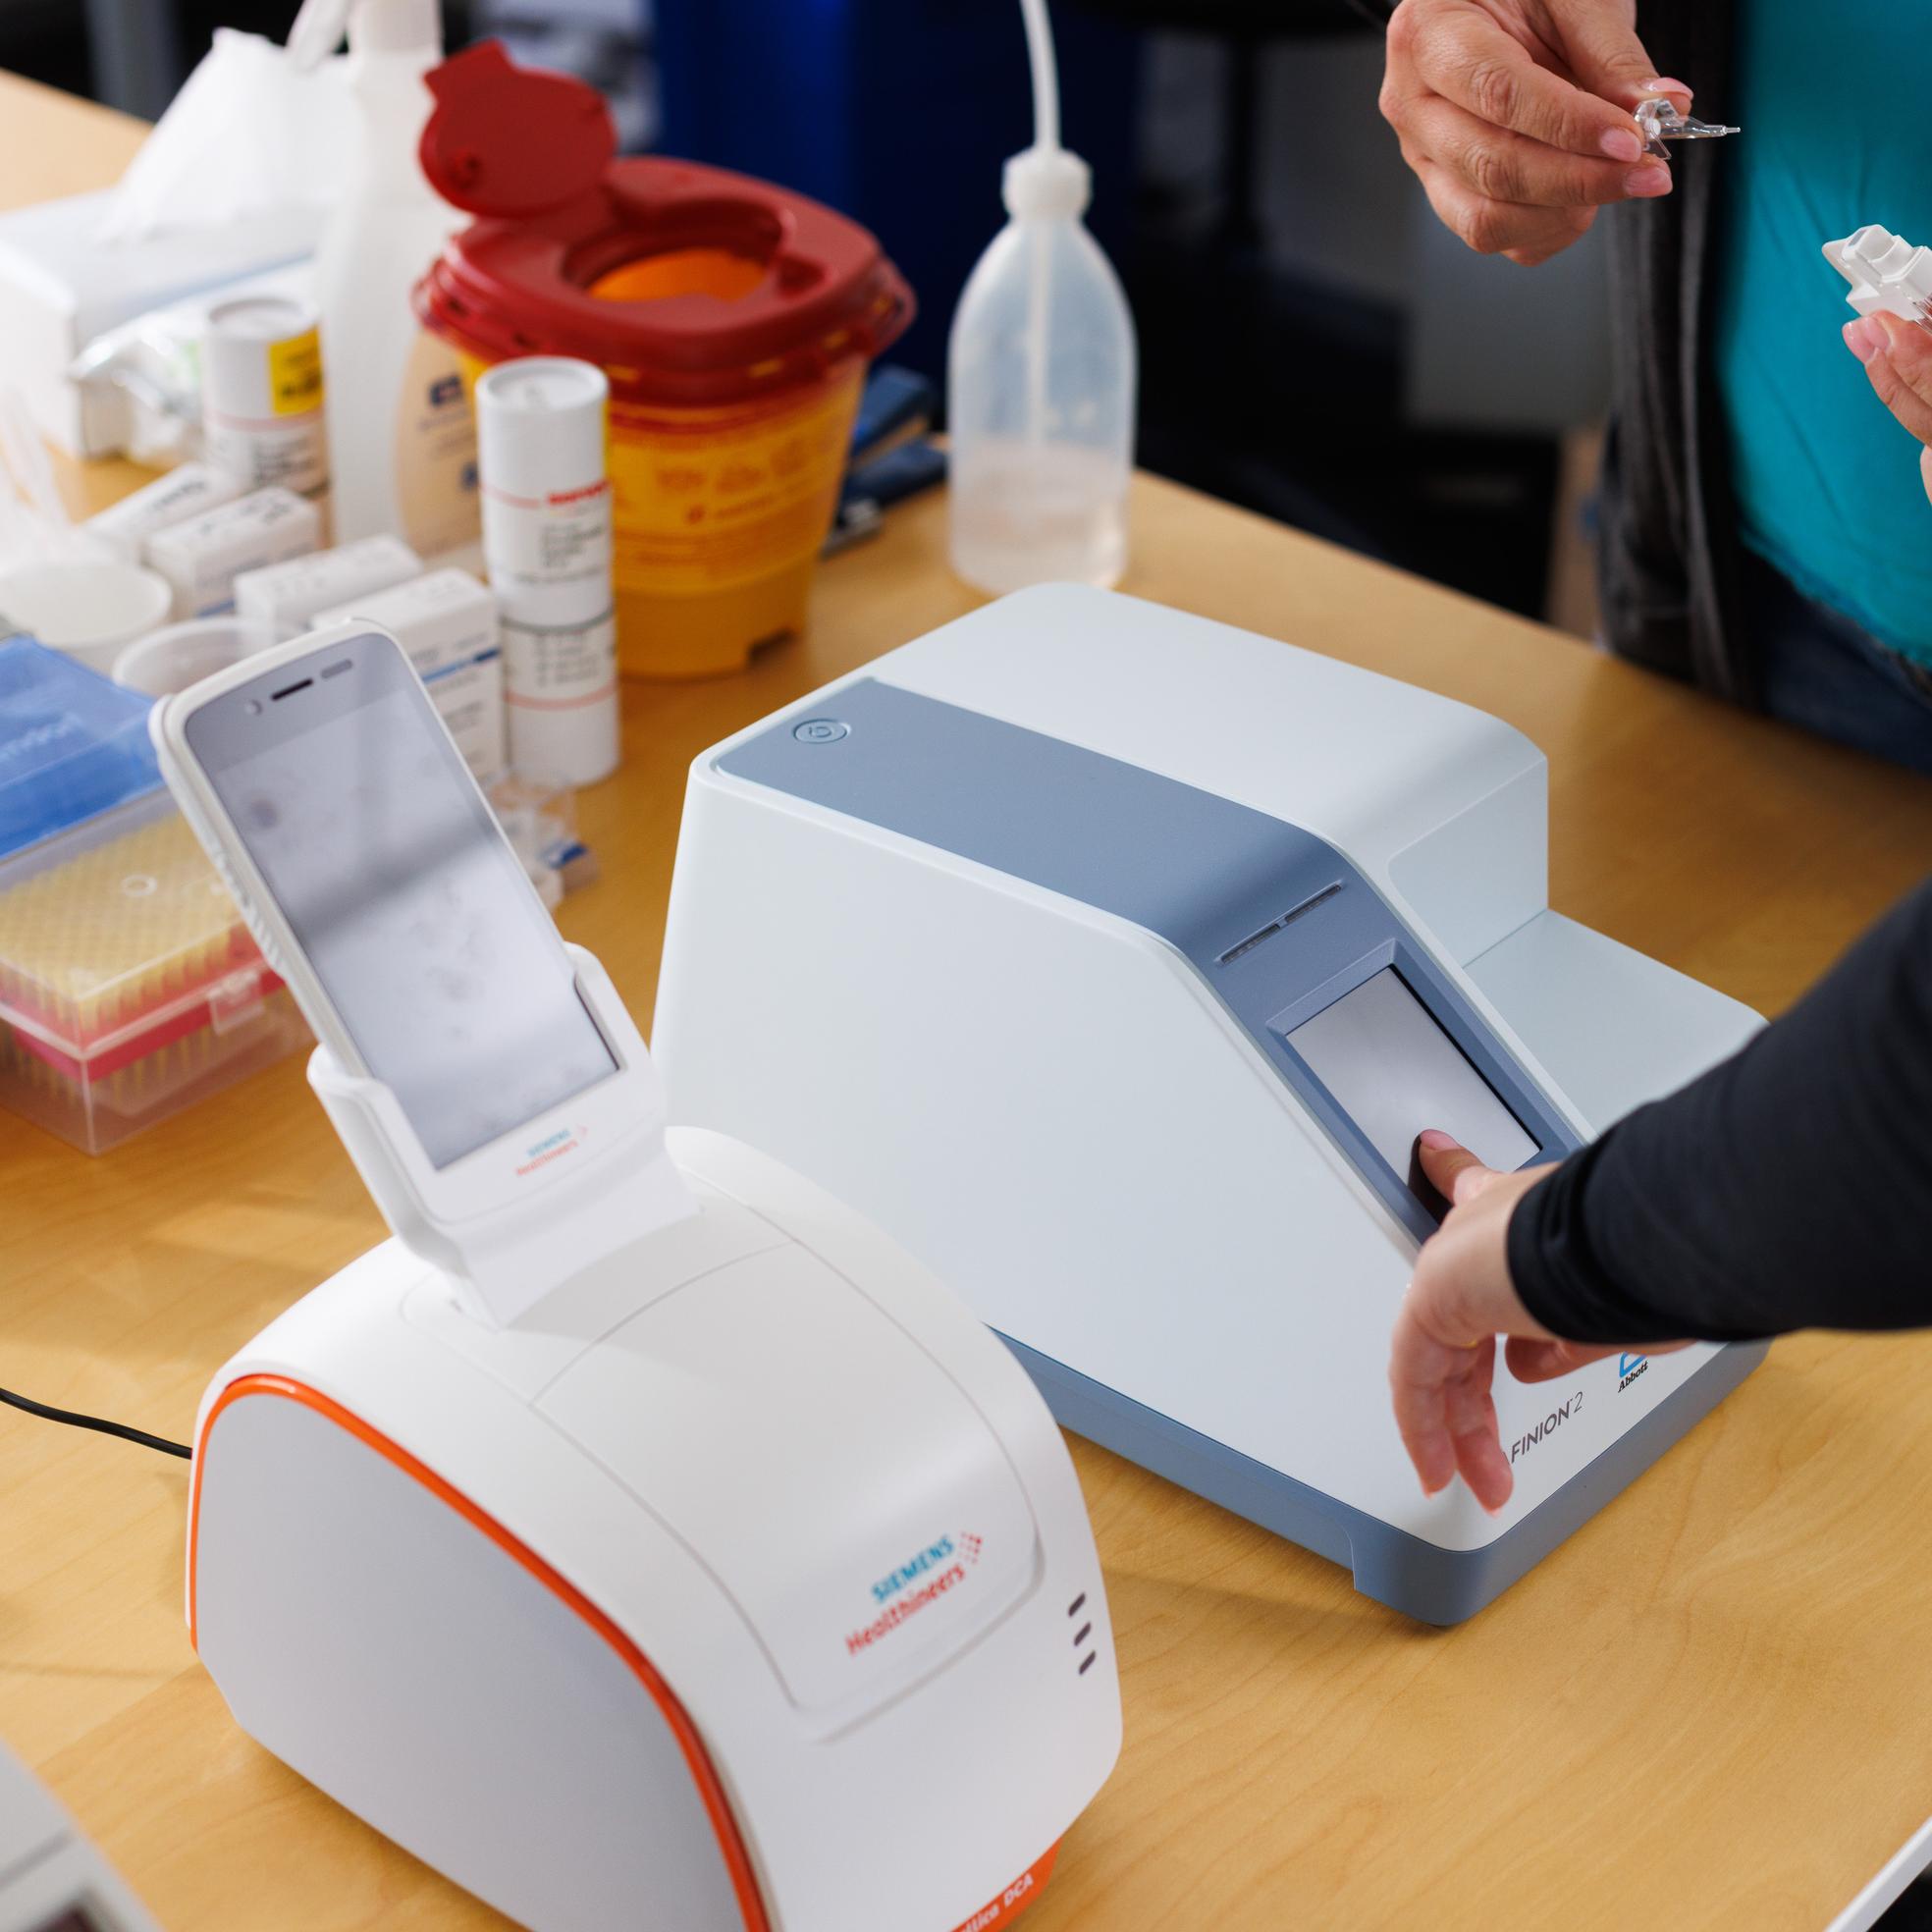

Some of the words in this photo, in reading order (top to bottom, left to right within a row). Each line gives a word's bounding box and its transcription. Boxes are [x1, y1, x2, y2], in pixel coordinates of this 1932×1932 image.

[1617, 1360, 1649, 1393] Abbott
[1502, 1400, 1571, 1465] FINION
[1573, 1390, 1583, 1414] 2
[872, 1534, 954, 1603] SIEMENS
[845, 1564, 965, 1656] Healthineers
[1003, 1872, 1034, 1908] DCA
